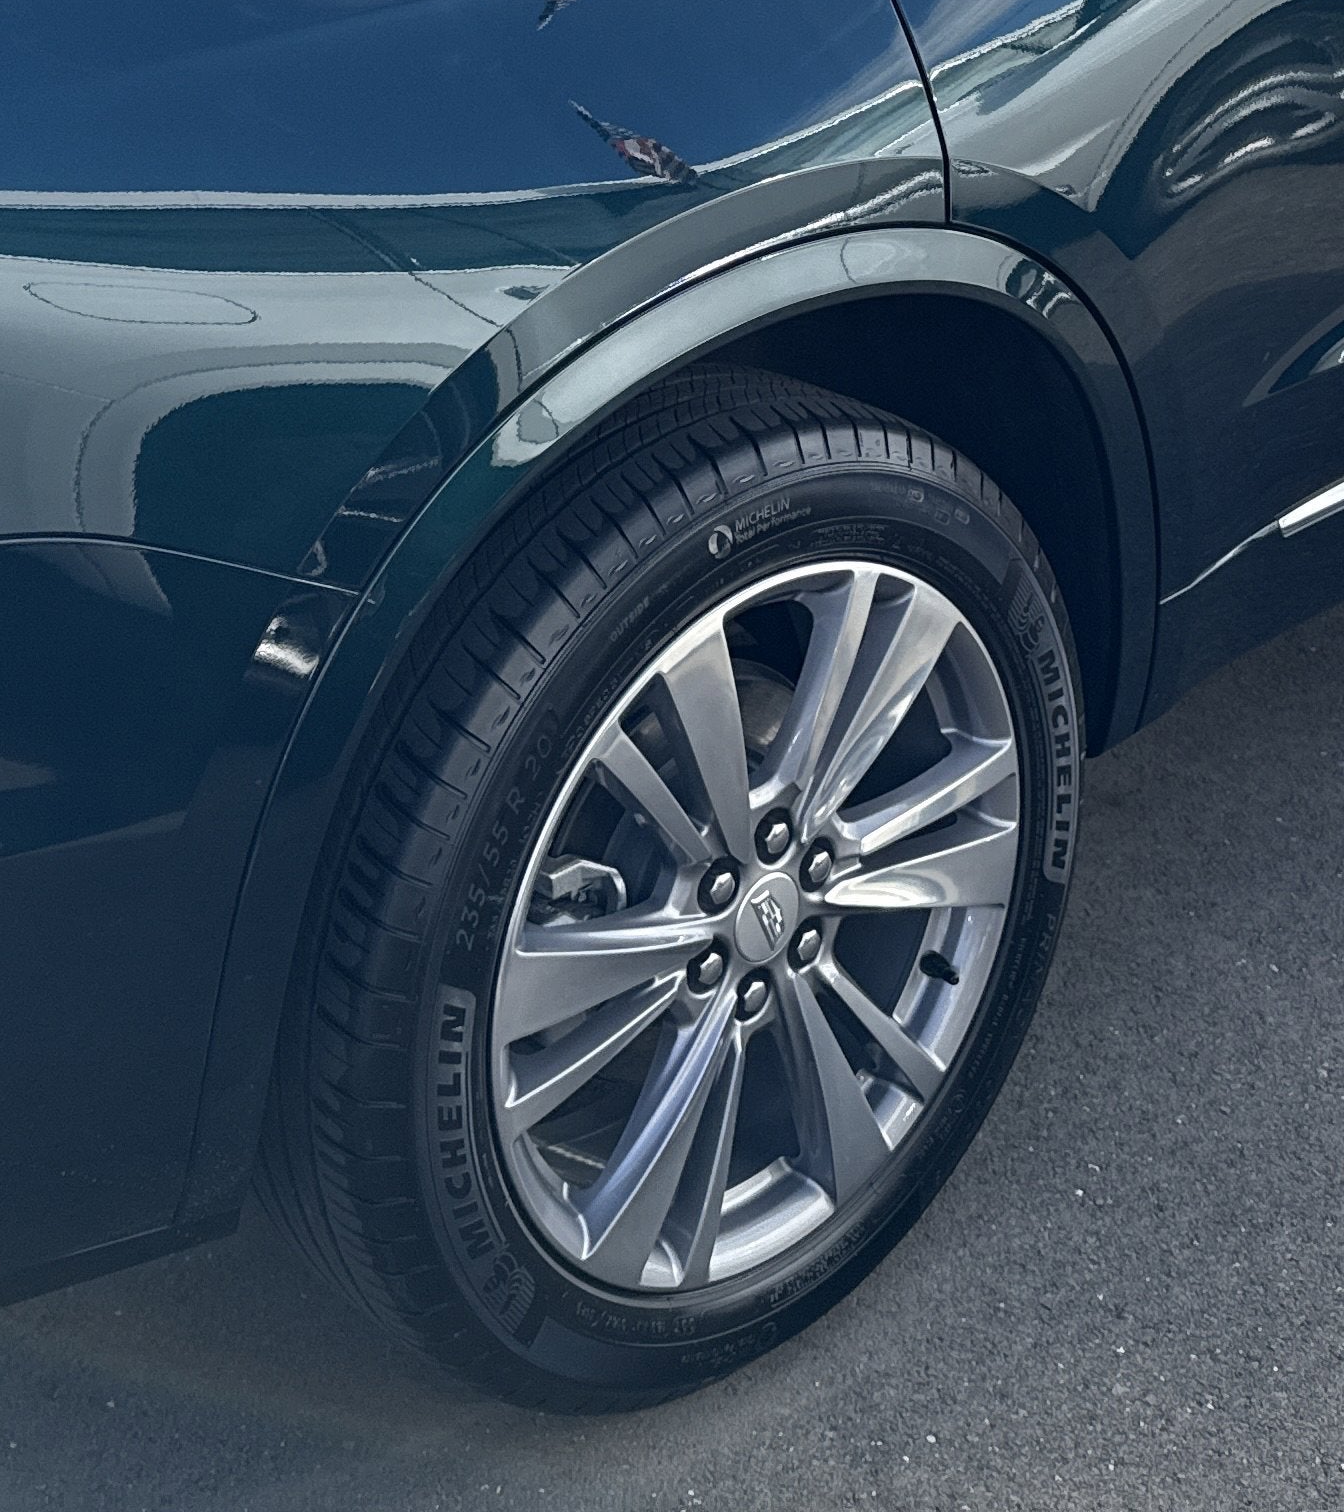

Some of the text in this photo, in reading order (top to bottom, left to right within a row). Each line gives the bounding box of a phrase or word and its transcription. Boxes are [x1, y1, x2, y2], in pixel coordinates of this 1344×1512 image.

[734, 524, 757, 544] Total
[756, 507, 812, 535] Performance
[735, 498, 791, 532] MICHELIN
[609, 595, 653, 643] OUTSIDE
[1037, 646, 1073, 871] MICHELIN
[457, 819, 509, 952] 235/55
[506, 787, 531, 816] R
[524, 734, 554, 782] 20
[437, 1002, 494, 1261] MICHELIN
